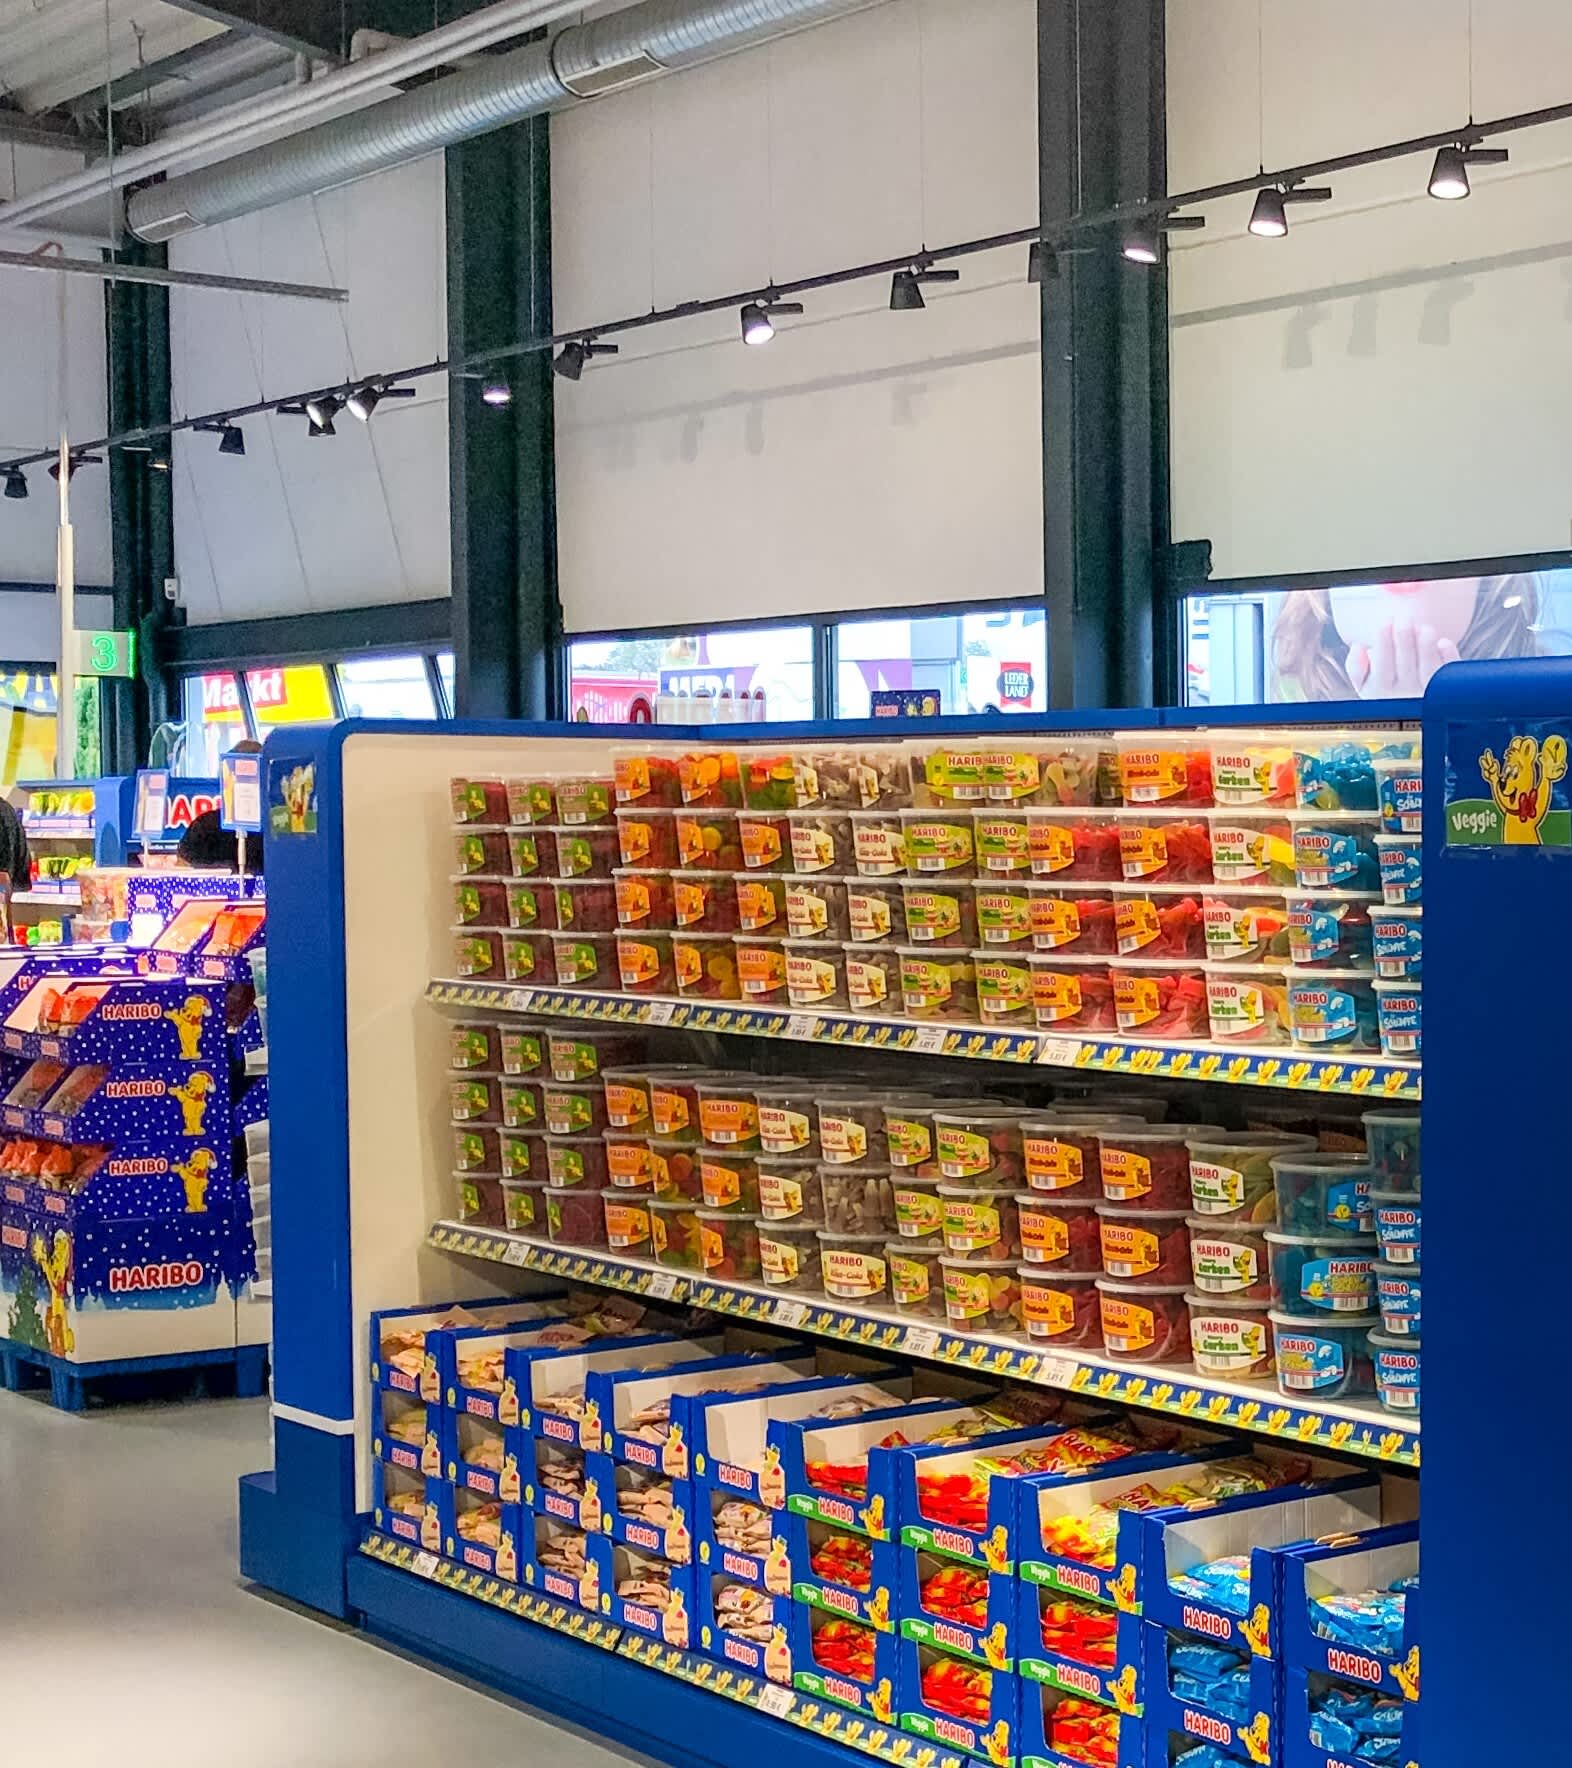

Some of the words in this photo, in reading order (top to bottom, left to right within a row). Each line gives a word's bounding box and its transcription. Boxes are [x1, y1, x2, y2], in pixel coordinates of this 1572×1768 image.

[91, 635, 118, 672] 3
[1126, 754, 1159, 765] HARIBO
[1216, 757, 1250, 768] HARIBO
[1395, 779, 1422, 793] HARI
[1451, 804, 1497, 833] Veggie
[857, 833, 886, 843] HARIBO
[912, 826, 946, 837] HARIBO
[983, 826, 1018, 837] HARIBO
[1296, 836, 1330, 848] HARIBO
[980, 898, 1011, 909] HARIBO
[1293, 993, 1327, 1004] HARIBO
[1383, 1000, 1417, 1012] HARIBO
[102, 1005, 162, 1019] HARIBO
[106, 1081, 166, 1097] HARIBO
[707, 1103, 738, 1113] HARIBO
[938, 1133, 966, 1145] HARIBO
[1027, 1142, 1058, 1155] HARIBO
[109, 1158, 168, 1175] HARIBO
[1379, 1212, 1414, 1224] HARIBO
[1104, 1228, 1134, 1242] HARIBO
[830, 1255, 862, 1266] HARIBO
[1196, 1244, 1230, 1257] HARIBO
[110, 1262, 203, 1292] HARIBO
[1201, 1322, 1239, 1334] HARIBO
[1280, 1338, 1315, 1351] HARIBO
[1380, 1354, 1417, 1368] HARIBO
[466, 1396, 494, 1418] HARIBO
[543, 1418, 575, 1442] HARIBO
[392, 1447, 417, 1469] HARIBO
[624, 1442, 657, 1467] HARIBO
[467, 1471, 495, 1494] HARIBO
[719, 1464, 752, 1490] HARIBO
[545, 1494, 575, 1519] HARIBO
[818, 1498, 854, 1524] HARIBO
[392, 1517, 417, 1540] HARIBO
[626, 1523, 659, 1549] HARIBO
[933, 1528, 973, 1555] HARIBO
[464, 1547, 491, 1571] HARIBO
[724, 1553, 757, 1580] HARIBO
[545, 1574, 575, 1600] HARIBO
[1056, 1564, 1100, 1595] HARIBO
[822, 1586, 858, 1613] HARIBO
[624, 1605, 657, 1631] HARIBO
[1184, 1606, 1231, 1640] HARIBO
[934, 1624, 973, 1650] HARIBO
[725, 1639, 758, 1667] HARIBO
[1327, 1648, 1382, 1684] HARIBO
[1056, 1664, 1100, 1694] HARIBO
[824, 1677, 862, 1705] HARIBO
[935, 1718, 975, 1748] HARIBO
[1184, 1708, 1231, 1745] HARIBO
